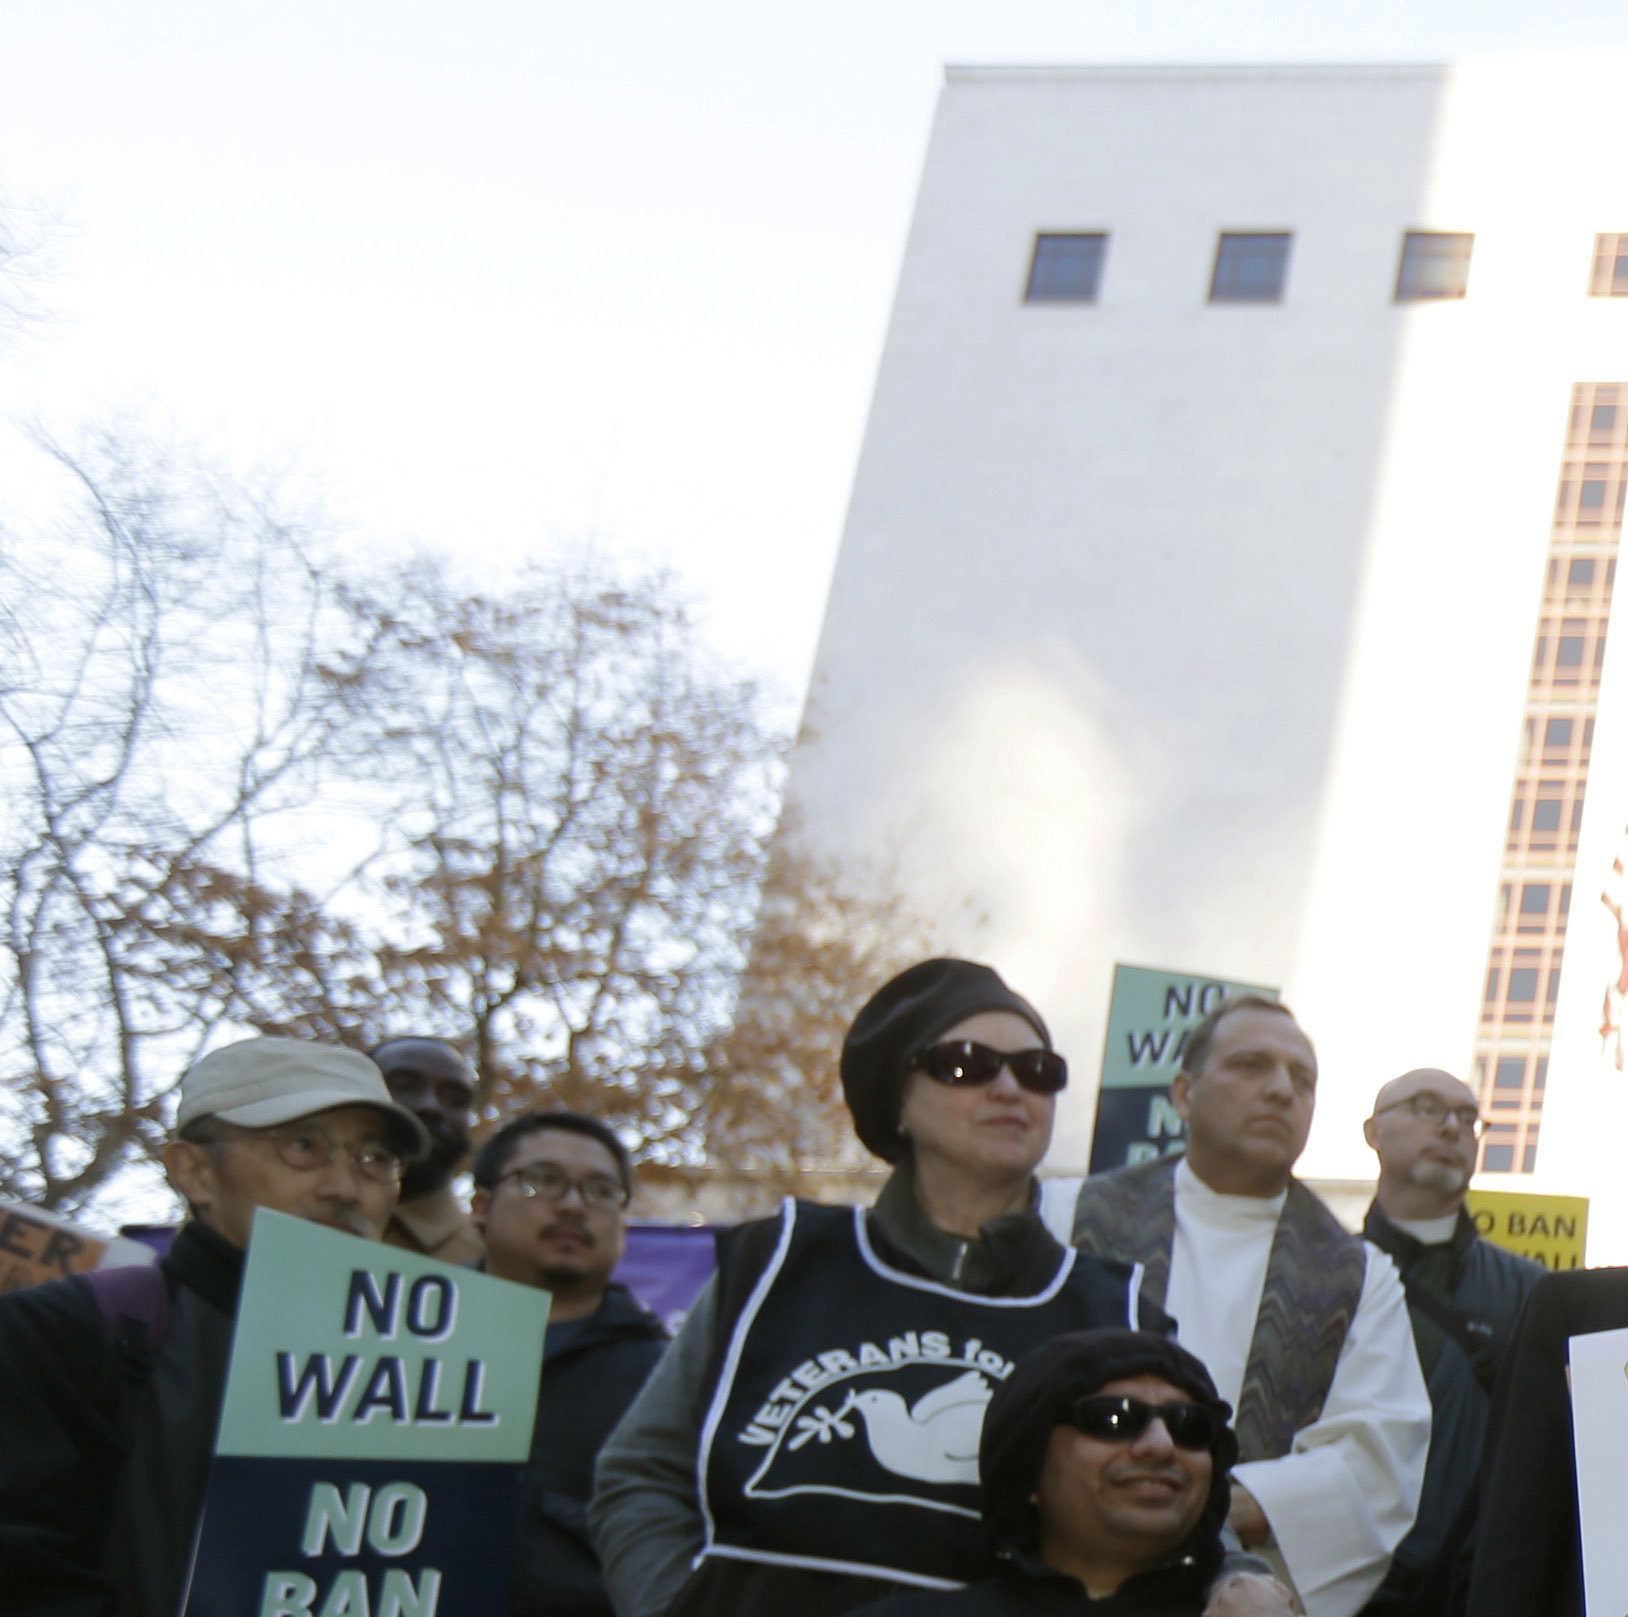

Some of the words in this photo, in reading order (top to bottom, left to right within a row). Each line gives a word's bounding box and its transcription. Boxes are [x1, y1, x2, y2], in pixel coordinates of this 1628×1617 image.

[1508, 1211, 1576, 1239] BAN
[343, 1270, 457, 1343] NO
[276, 1351, 499, 1427] WALL
[738, 1331, 951, 1446] VETERANS
[302, 1480, 427, 1557] NO
